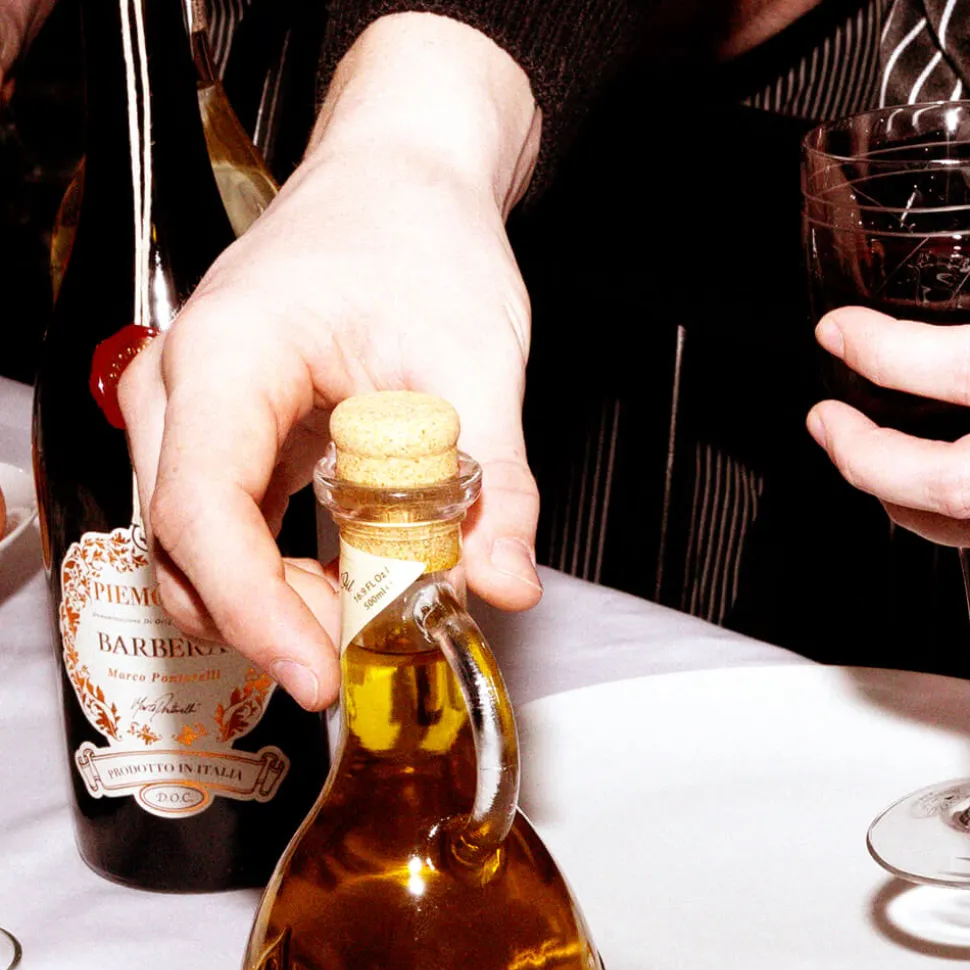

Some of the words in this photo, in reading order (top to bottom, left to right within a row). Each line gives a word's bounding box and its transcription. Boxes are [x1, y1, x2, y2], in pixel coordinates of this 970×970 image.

[93, 581, 161, 608] PIEM
[107, 667, 146, 682] Marco
[107, 762, 175, 780] PRODOTTO
[178, 763, 194, 774] IN
[195, 764, 242, 781] ITALIA
